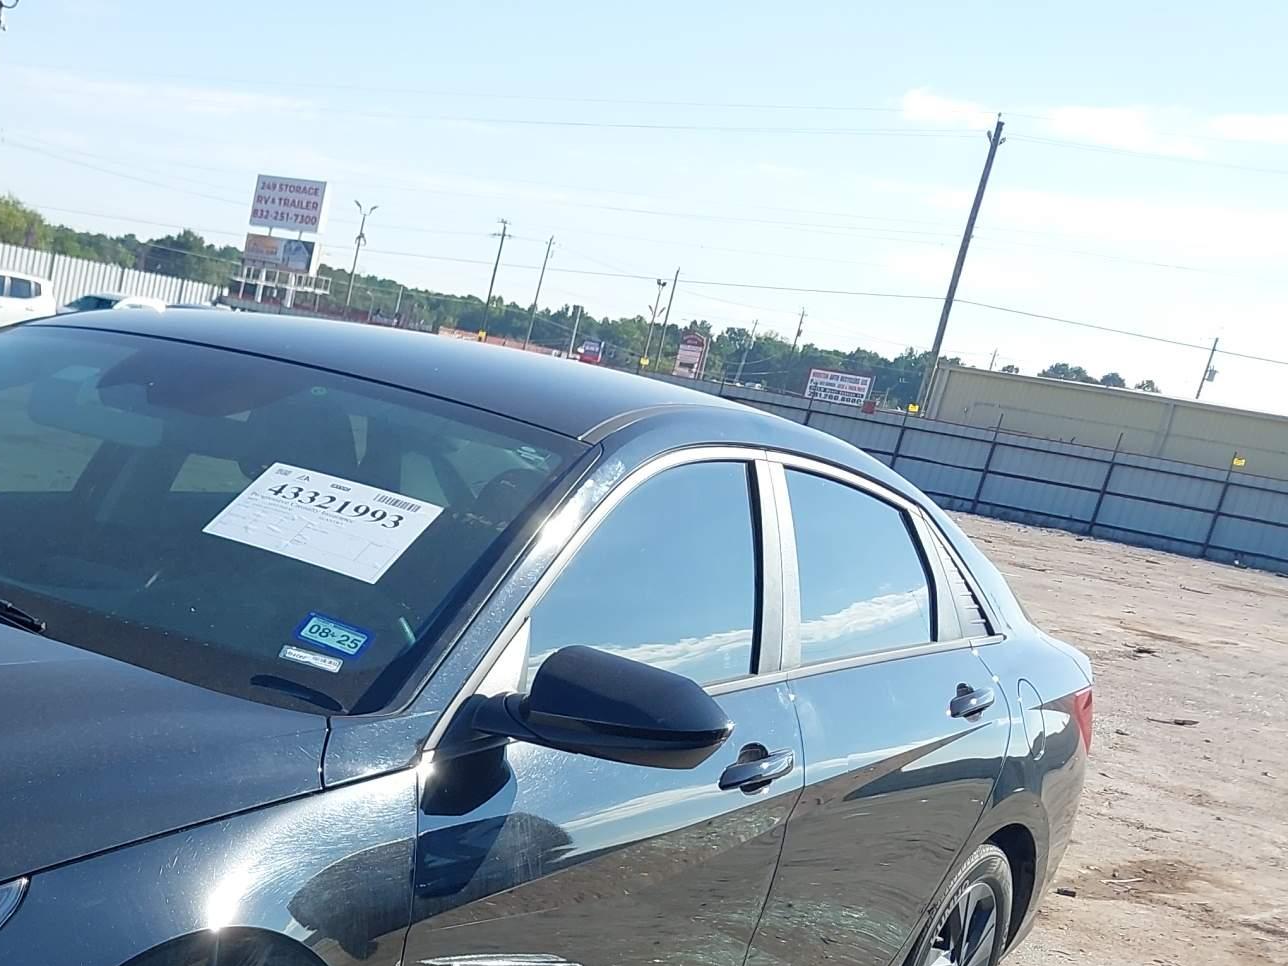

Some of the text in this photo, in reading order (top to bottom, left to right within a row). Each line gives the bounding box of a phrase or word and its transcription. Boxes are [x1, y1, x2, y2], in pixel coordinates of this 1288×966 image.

[278, 184, 320, 196] STORAGE
[256, 195, 270, 205] RV
[278, 198, 319, 211] TRAILER
[267, 483, 404, 528] 43321993
[308, 624, 362, 649] 08 25
